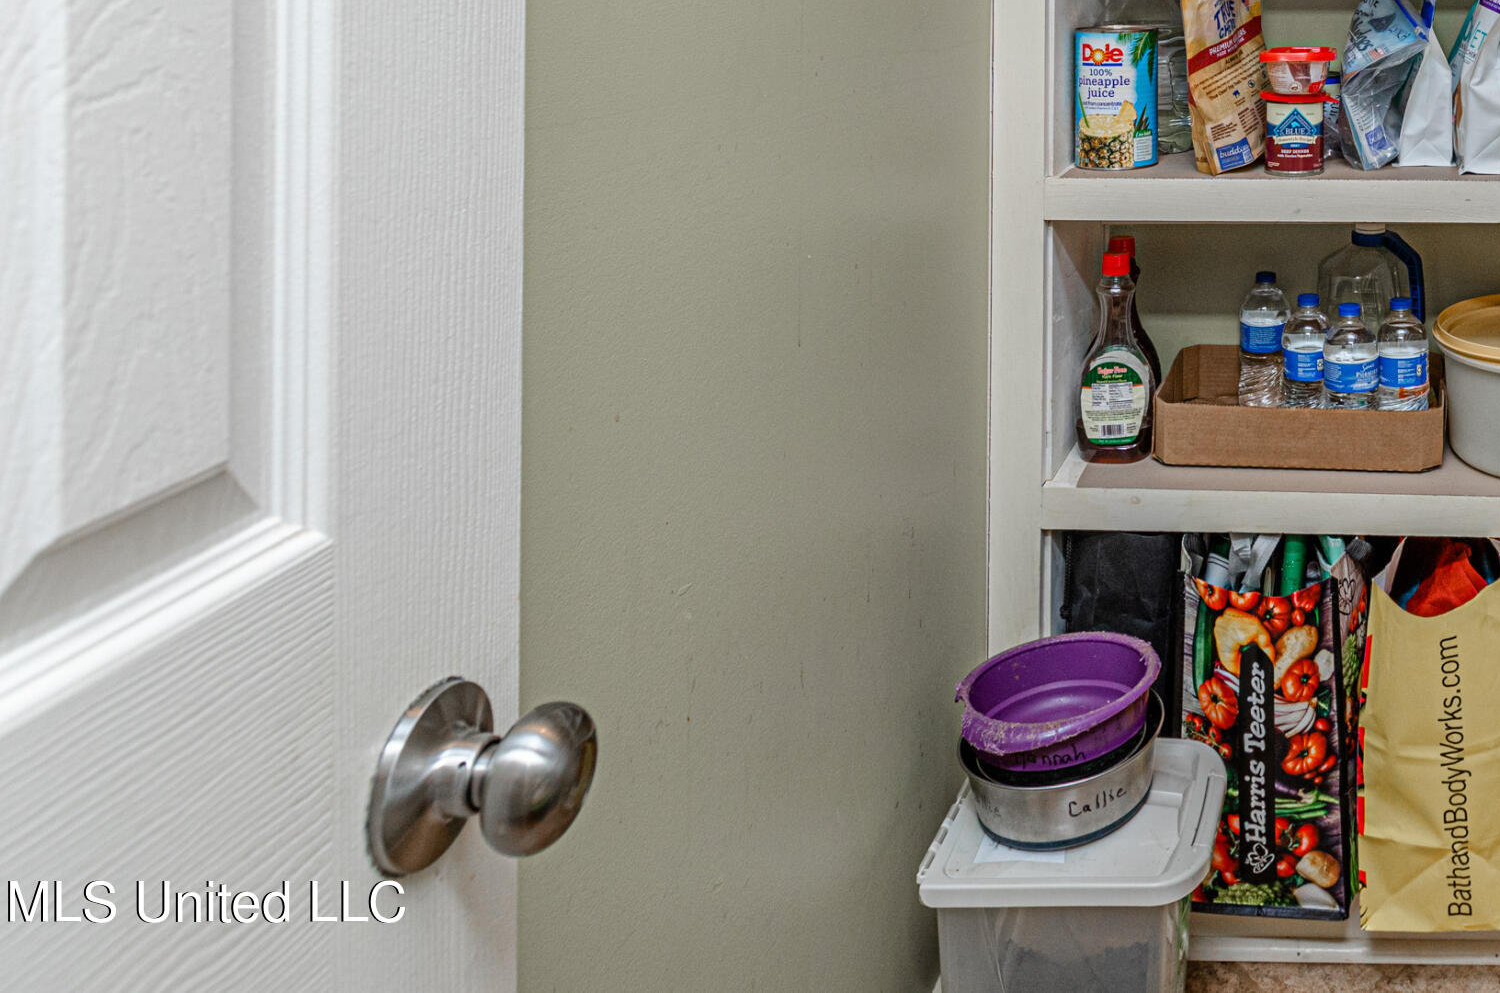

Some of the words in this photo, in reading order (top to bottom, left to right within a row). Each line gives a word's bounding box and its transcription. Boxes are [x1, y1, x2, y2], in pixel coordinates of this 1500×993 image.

[1081, 43, 1124, 65] Dole
[1078, 76, 1131, 88] pineapple
[1089, 68, 1113, 77] 100%
[1087, 87, 1115, 99] juice
[1243, 661, 1268, 751] Teeter
[1438, 634, 1473, 918] BathandBodyWorks.com
[1068, 787, 1128, 818] Callie
[1243, 755, 1268, 846] Harris
